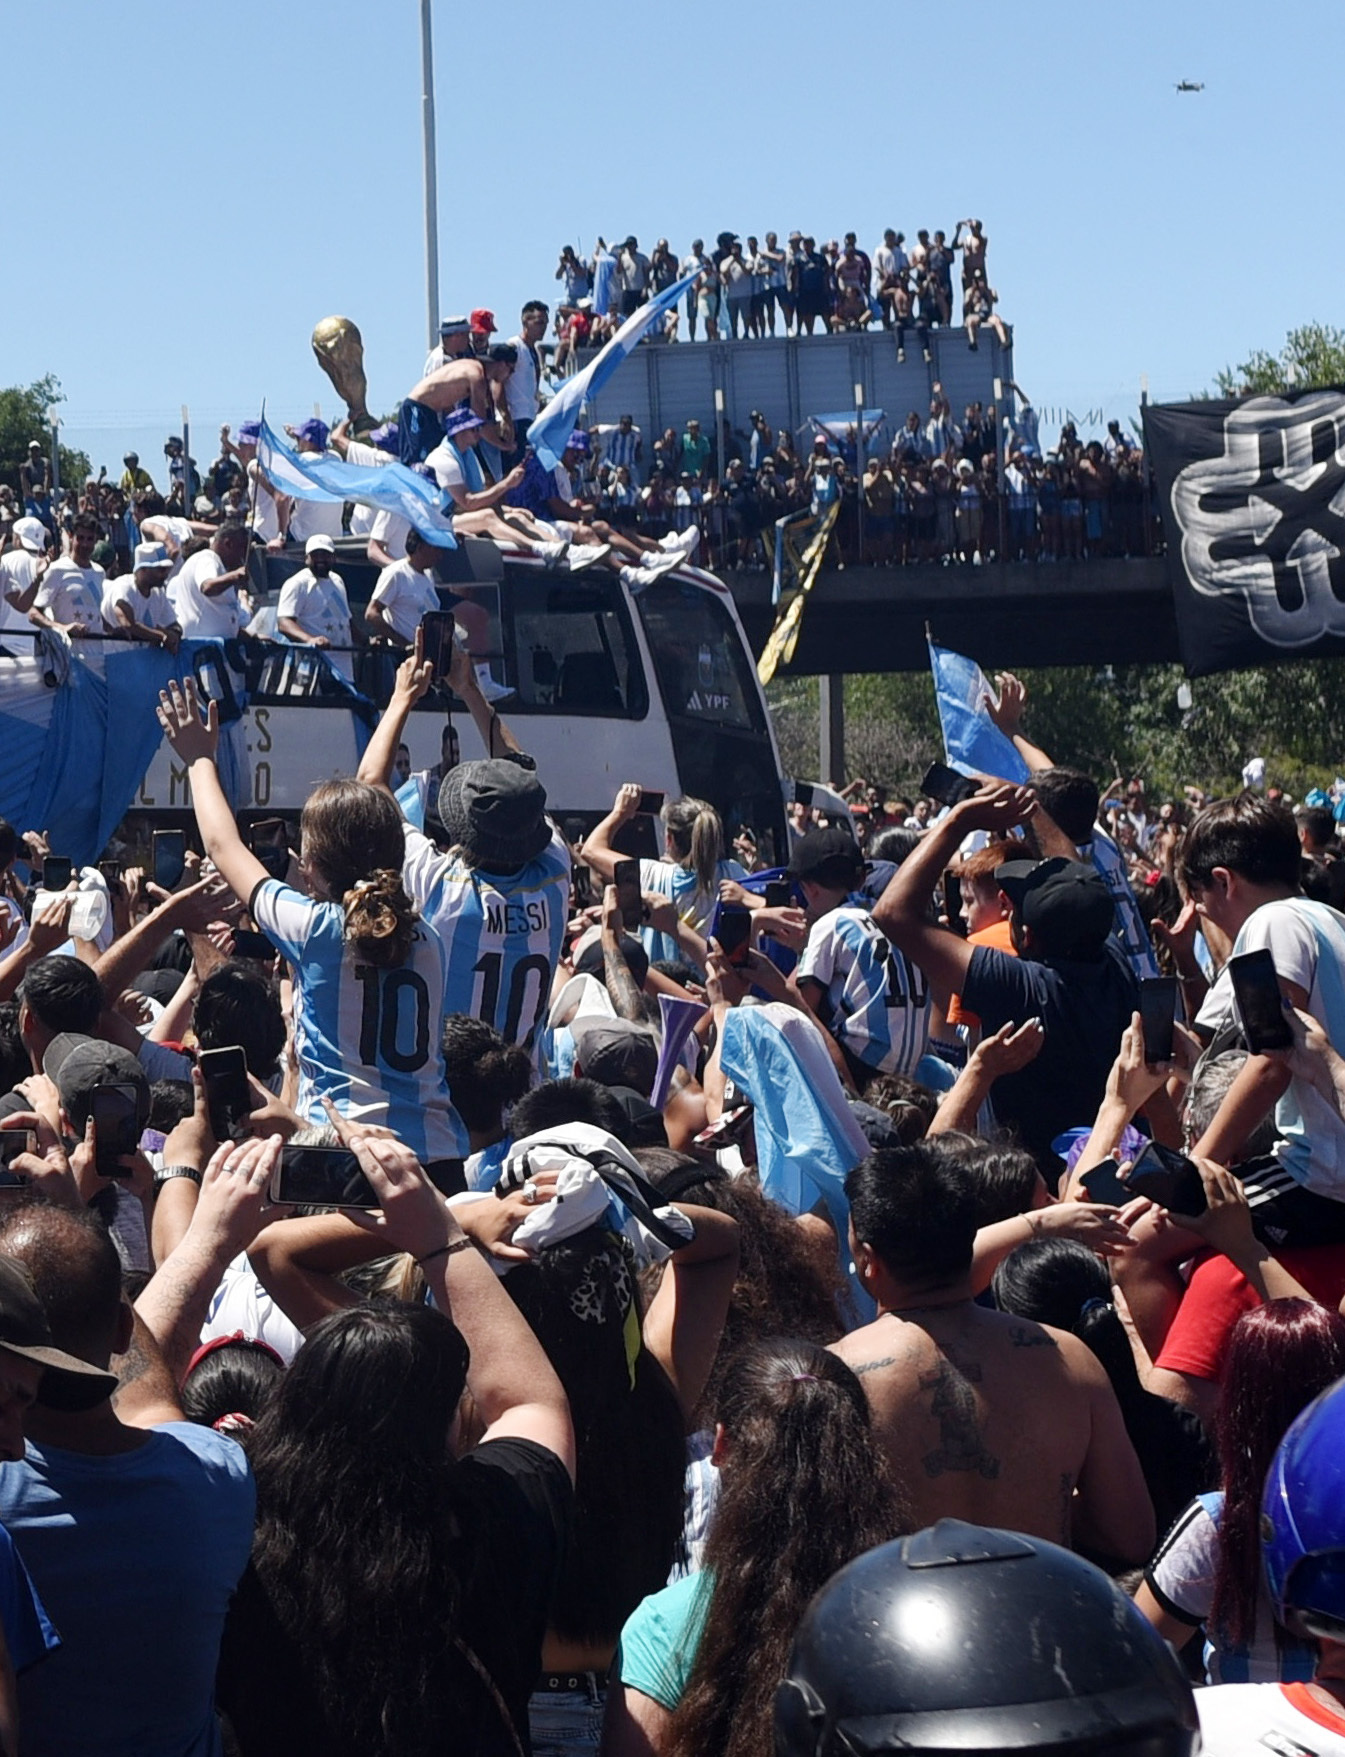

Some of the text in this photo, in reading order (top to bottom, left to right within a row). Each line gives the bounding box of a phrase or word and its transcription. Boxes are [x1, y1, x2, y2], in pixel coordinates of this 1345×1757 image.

[704, 694, 729, 710] YPF
[486, 898, 548, 934] MESSI
[355, 964, 430, 1073] 10
[471, 953, 551, 1050] 10
